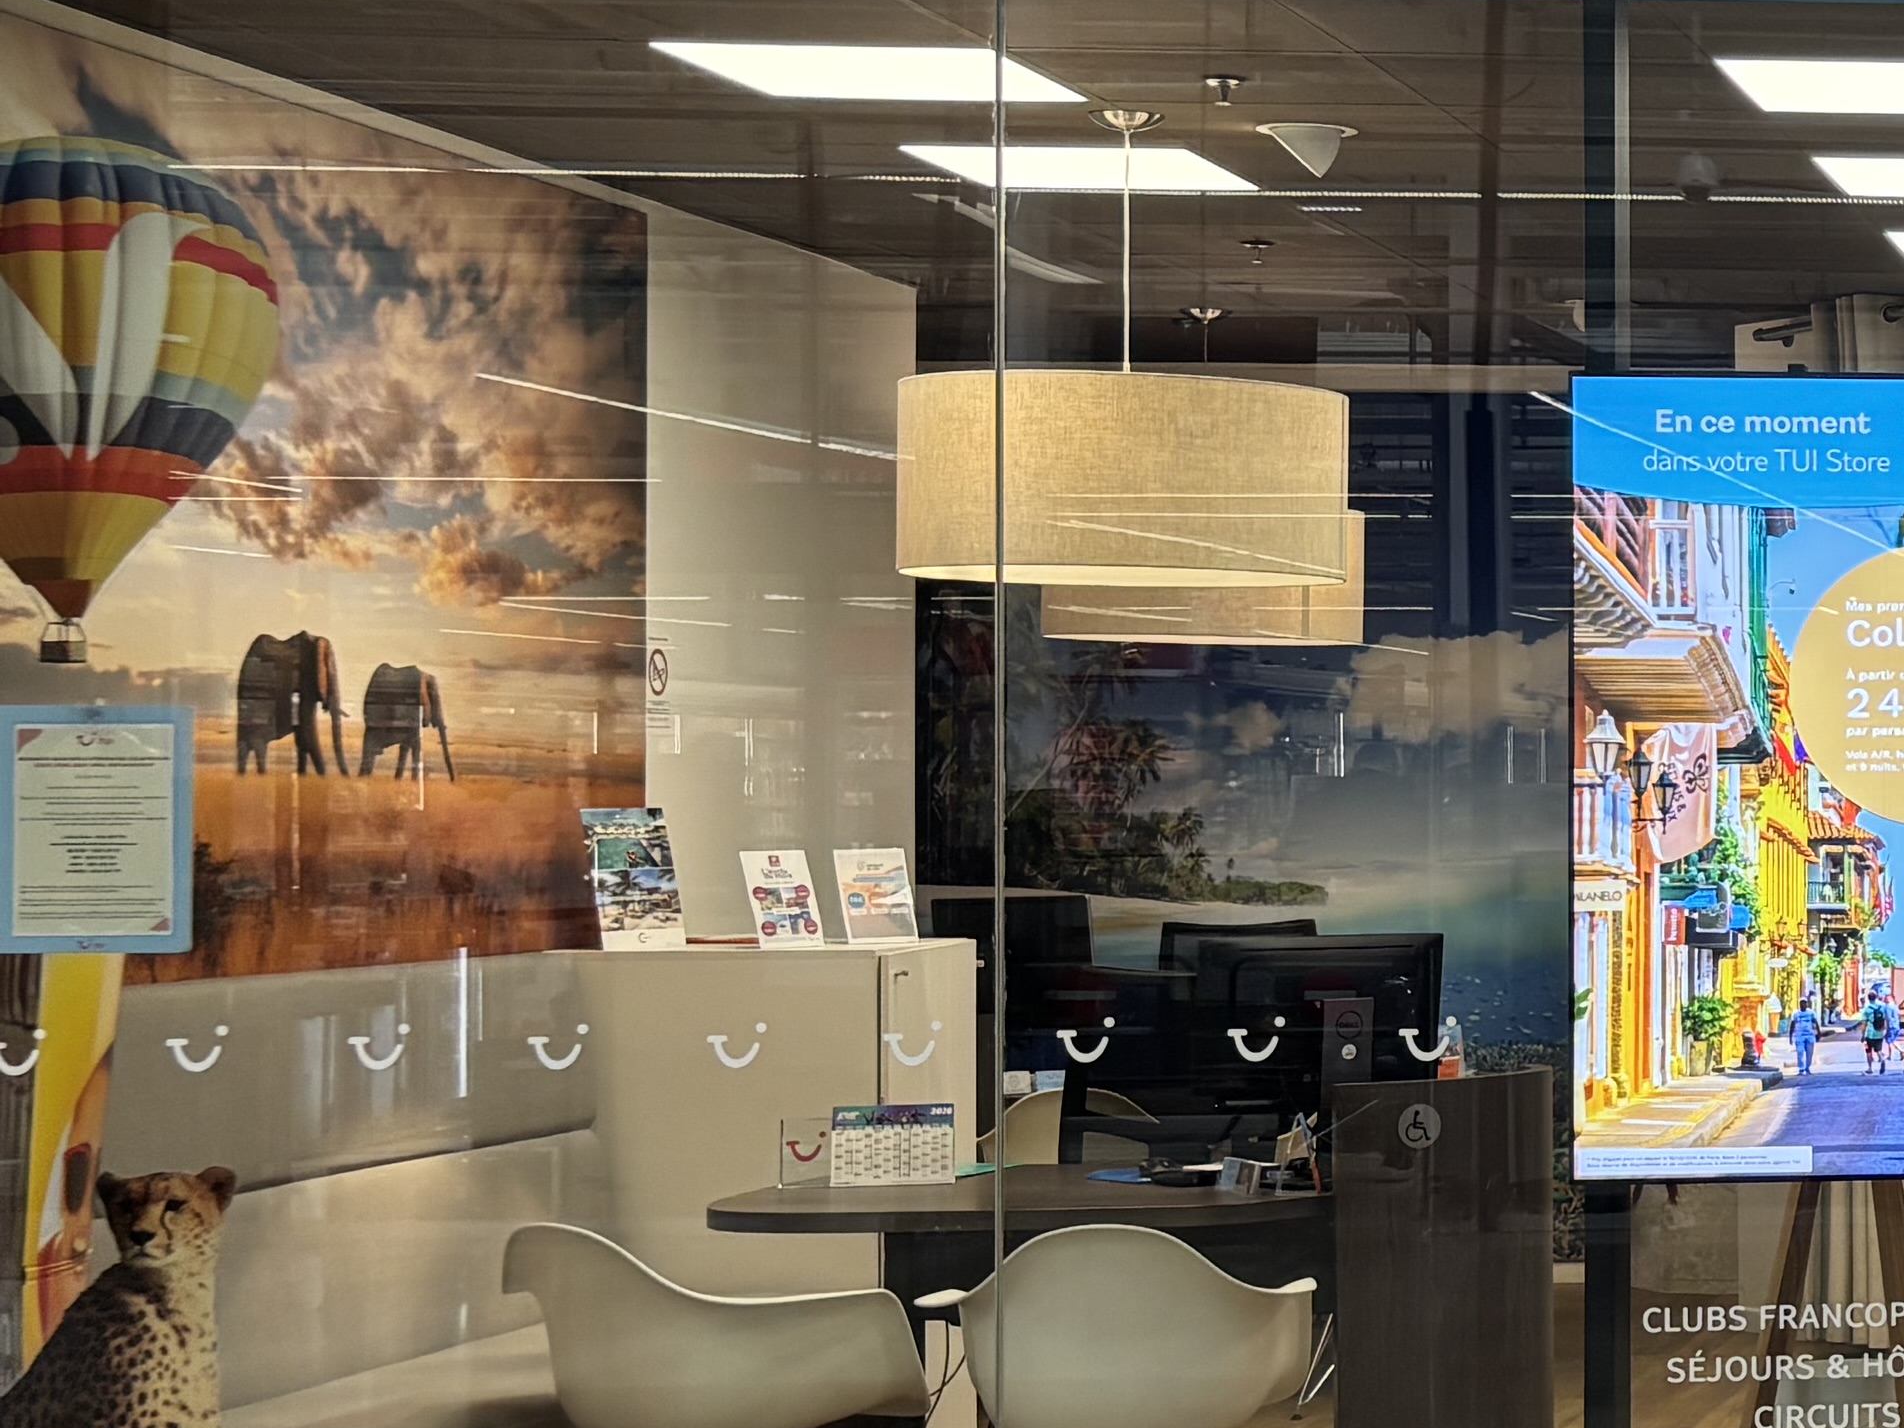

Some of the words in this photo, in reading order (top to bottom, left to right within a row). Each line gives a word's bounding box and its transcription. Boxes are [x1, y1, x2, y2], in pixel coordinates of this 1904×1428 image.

[1656, 409, 1692, 433] En
[1700, 415, 1735, 433] ce
[1744, 413, 1871, 434] moment
[1643, 448, 1700, 471] dans
[1707, 452, 1768, 472] votre
[1774, 449, 1818, 472] TUI
[1826, 449, 1890, 472] Store
[1858, 669, 1895, 683] partir
[1846, 727, 1868, 738] par
[1642, 1305, 1748, 1334] CLUBS
[1666, 1350, 1815, 1384] SÉJOURS
[1827, 1354, 1851, 1381] &
